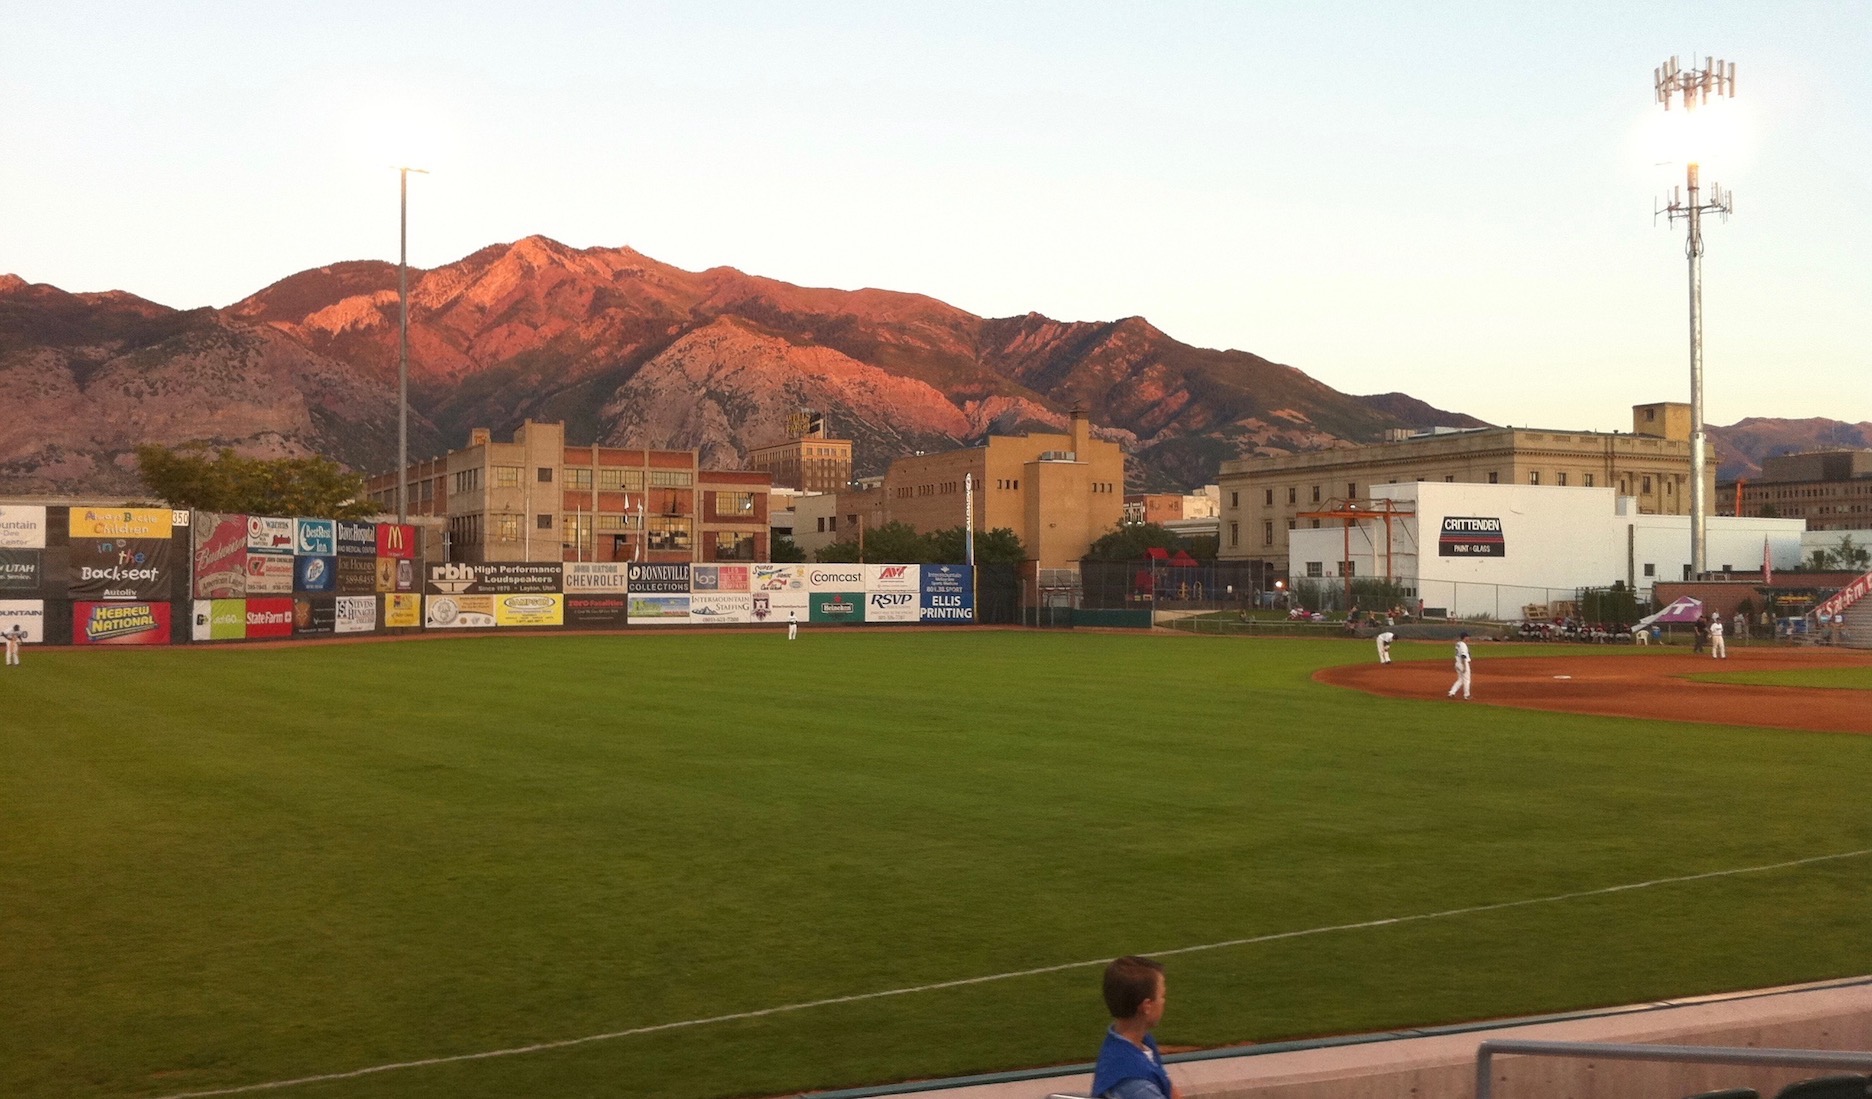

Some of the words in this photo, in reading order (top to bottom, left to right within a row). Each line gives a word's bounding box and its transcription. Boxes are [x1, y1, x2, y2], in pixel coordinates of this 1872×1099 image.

[172, 512, 188, 524] 350
[0, 521, 36, 529] untain
[94, 522, 148, 534] Children
[1444, 519, 1499, 530] CRITTENDEN
[119, 549, 144, 564] the
[6, 564, 35, 572] UTAH
[81, 566, 159, 581] Backseat
[432, 563, 474, 580] rbh
[474, 566, 497, 574] High
[642, 566, 688, 580] BONNEVILLE
[484, 576, 553, 584] Loudspeakers
[566, 575, 624, 586] CHEVROLET
[629, 583, 688, 591] COLLECTIONS
[871, 594, 912, 608] RSVP
[932, 596, 961, 606] ELLIS
[95, 606, 149, 620] HEBREW
[920, 608, 972, 618] PRINTING
[92, 616, 154, 632] NATIONAL
